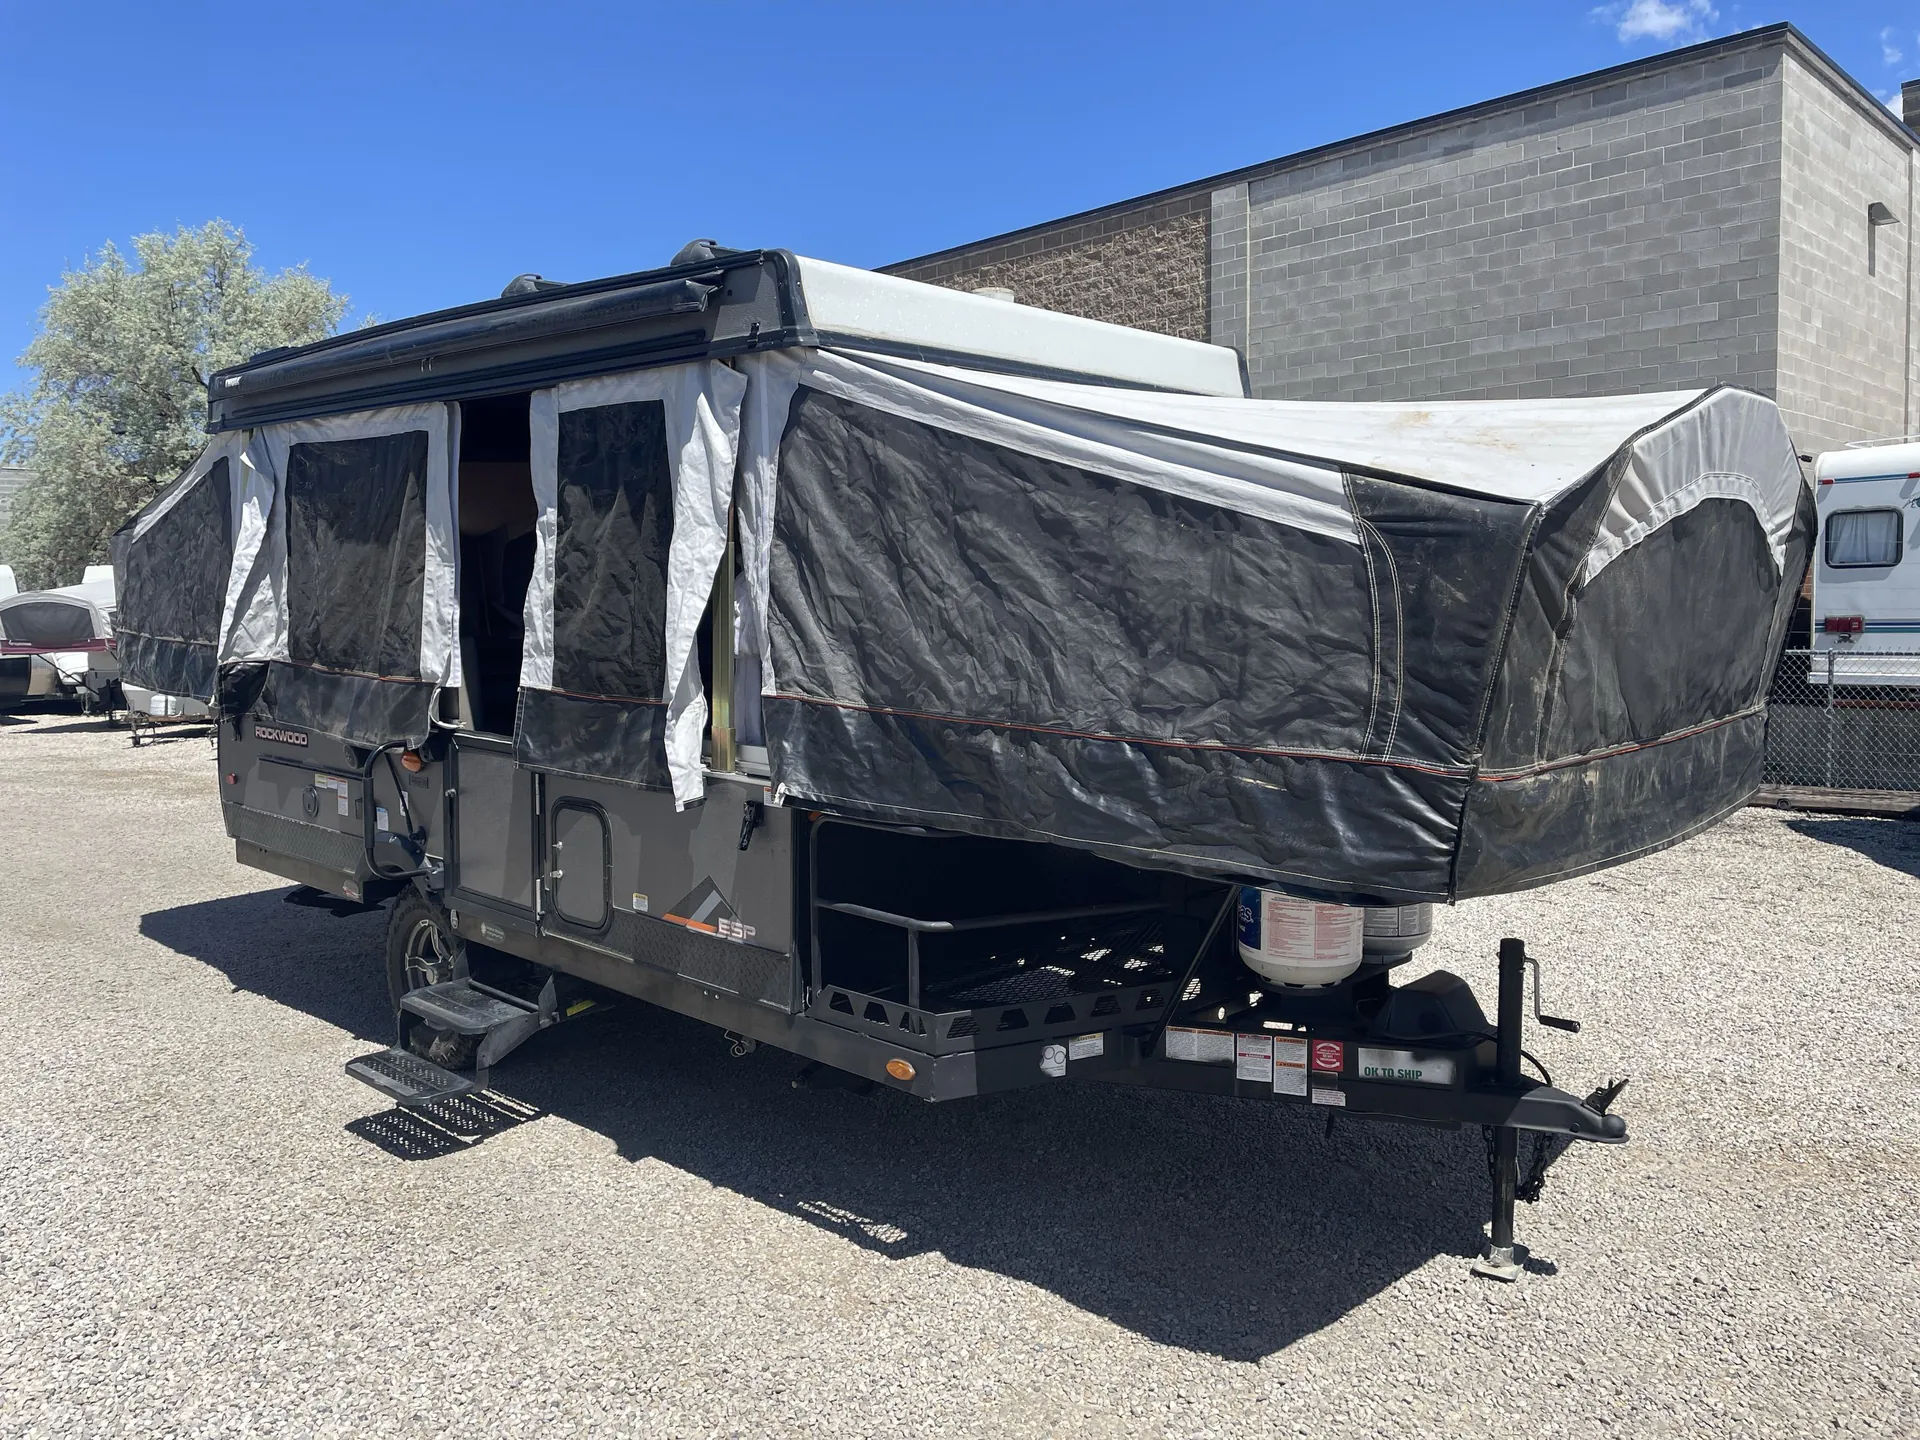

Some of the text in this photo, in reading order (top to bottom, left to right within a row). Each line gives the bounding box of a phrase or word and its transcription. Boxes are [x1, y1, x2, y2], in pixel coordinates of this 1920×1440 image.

[255, 726, 308, 745] ROCKWOOD
[718, 917, 756, 939] ESP
[1364, 1066, 1422, 1080] OK TO SHIP
